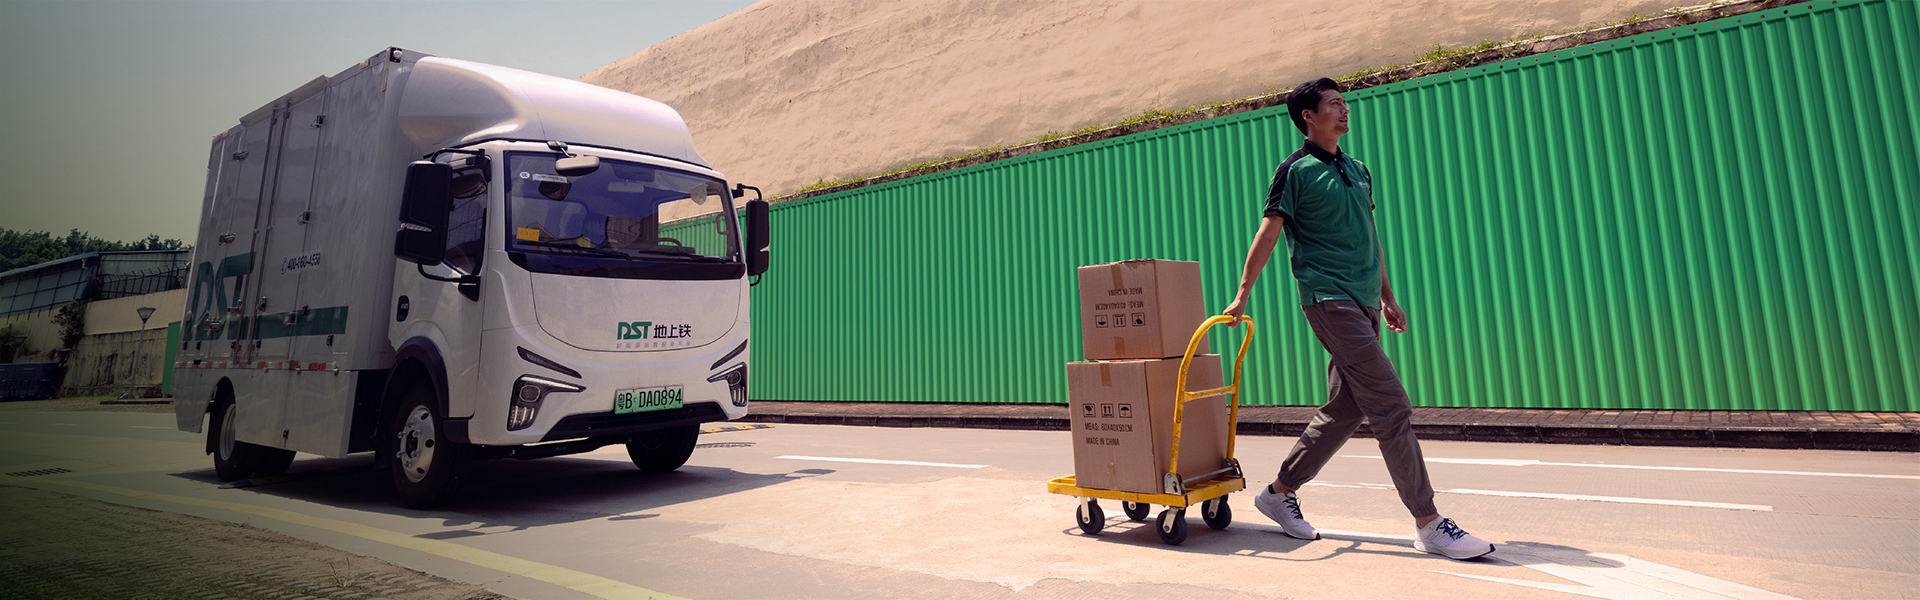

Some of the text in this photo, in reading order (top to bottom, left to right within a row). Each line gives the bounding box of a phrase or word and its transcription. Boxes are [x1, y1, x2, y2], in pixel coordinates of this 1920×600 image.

[1108, 287, 1143, 297] MADE IN CHINA
[617, 321, 652, 340] DST
[653, 323, 692, 339] 地上铁
[1085, 437, 1120, 446] MADE IN CHINA
